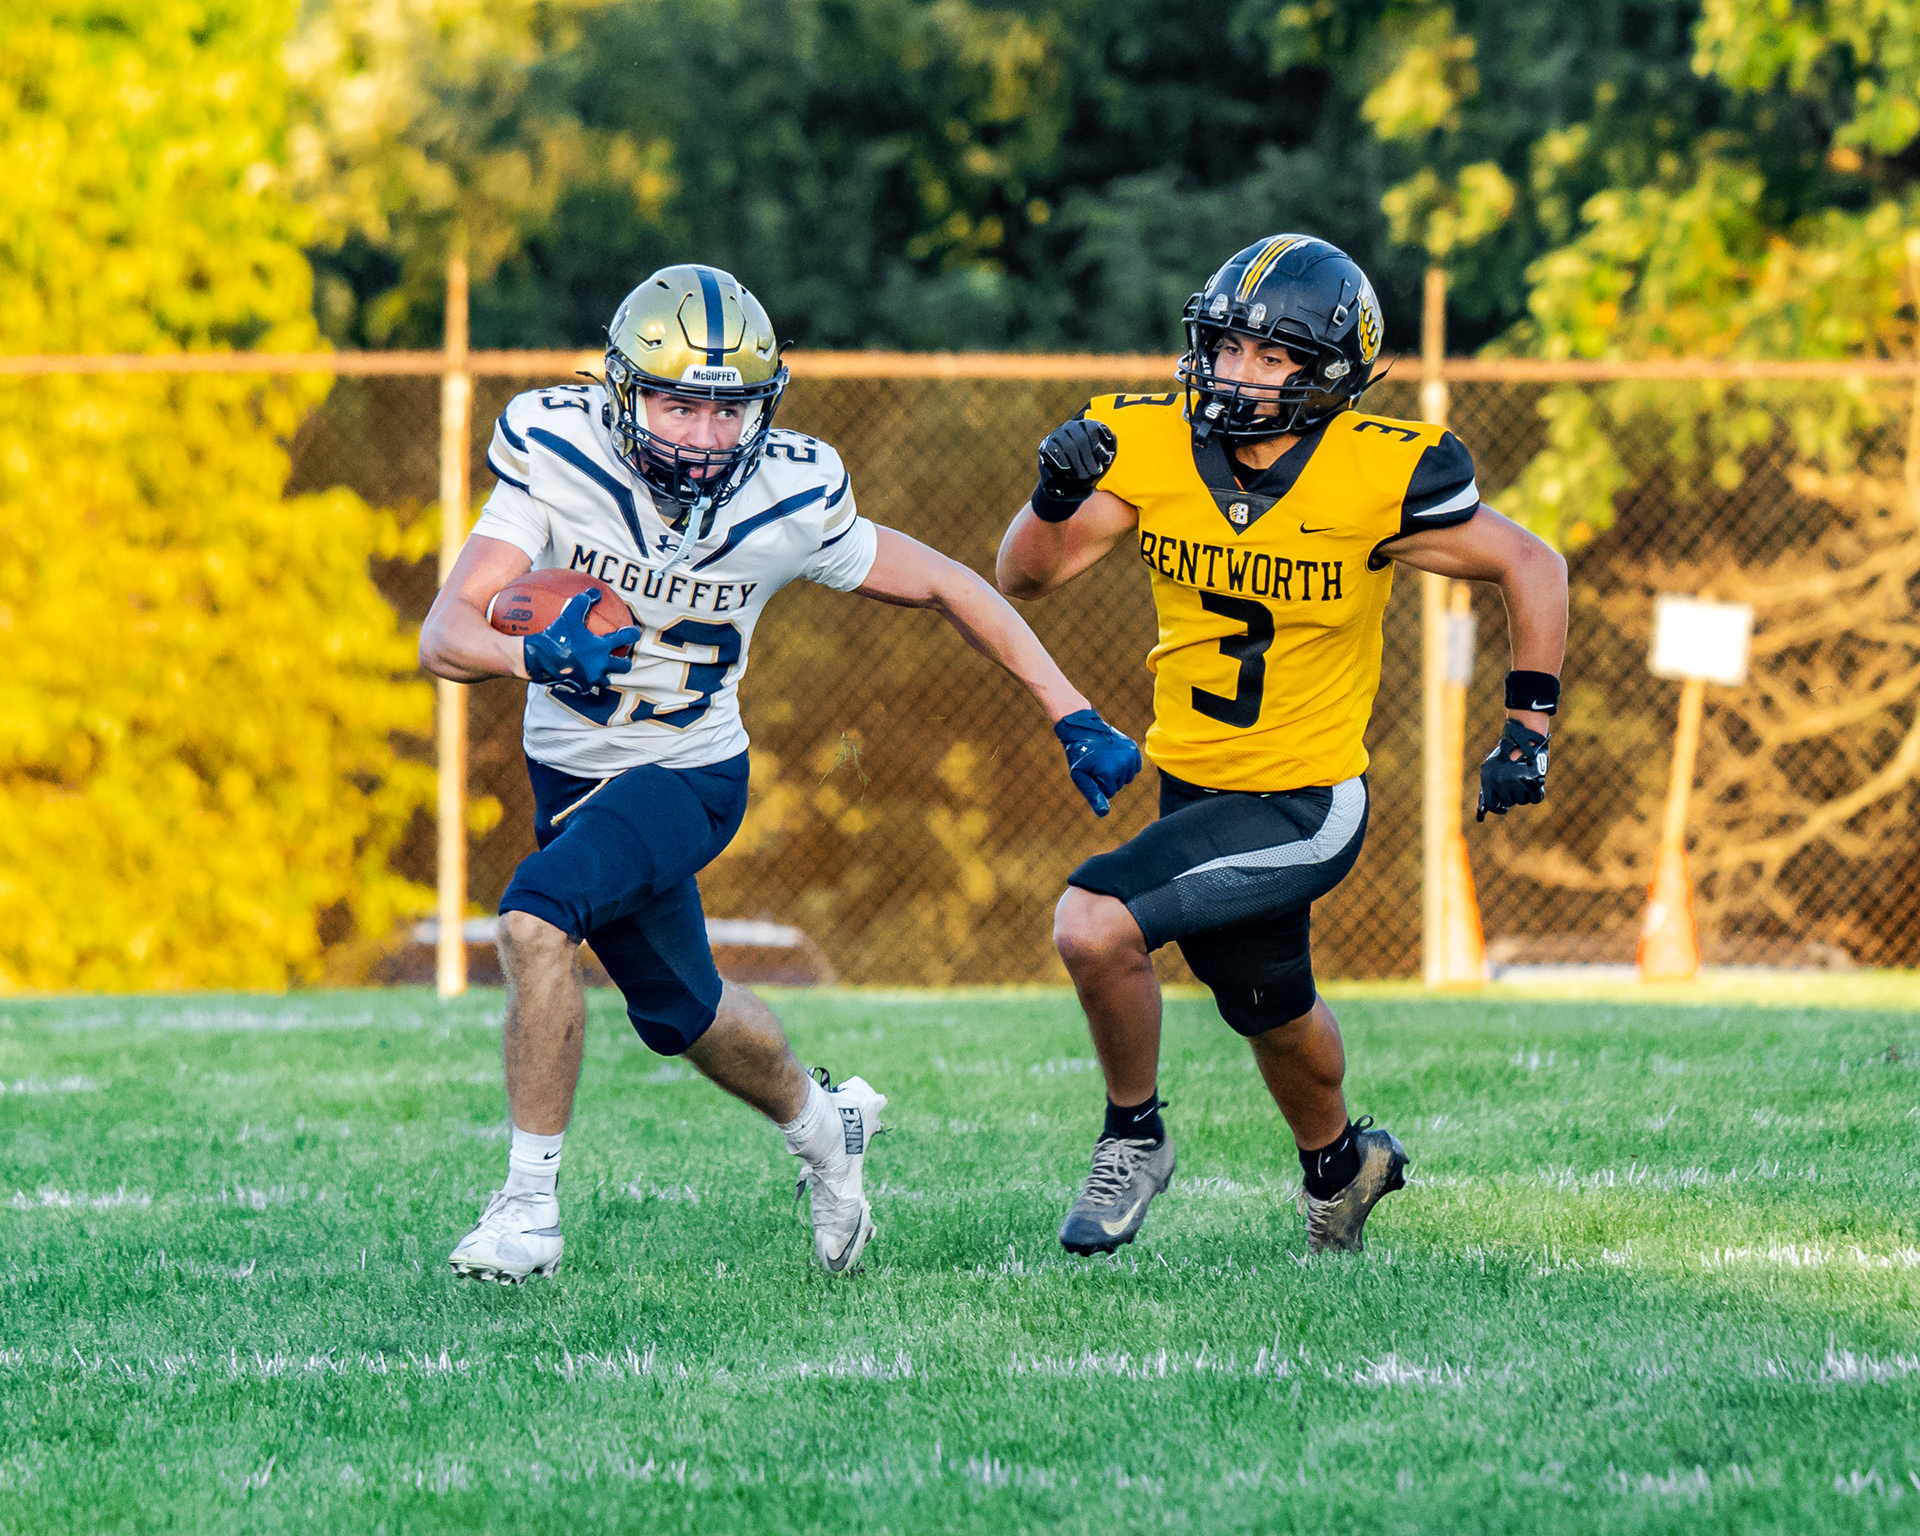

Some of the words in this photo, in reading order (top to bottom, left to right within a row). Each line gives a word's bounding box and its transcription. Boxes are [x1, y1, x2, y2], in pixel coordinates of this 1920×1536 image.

[692, 369, 737, 382] McGUFFEY
[1352, 420, 1421, 443] 3
[568, 542, 759, 613] MCGUFFEY
[1140, 529, 1344, 601] BENTWORTH
[1191, 590, 1275, 728] 3
[838, 1107, 864, 1155] NIKE
